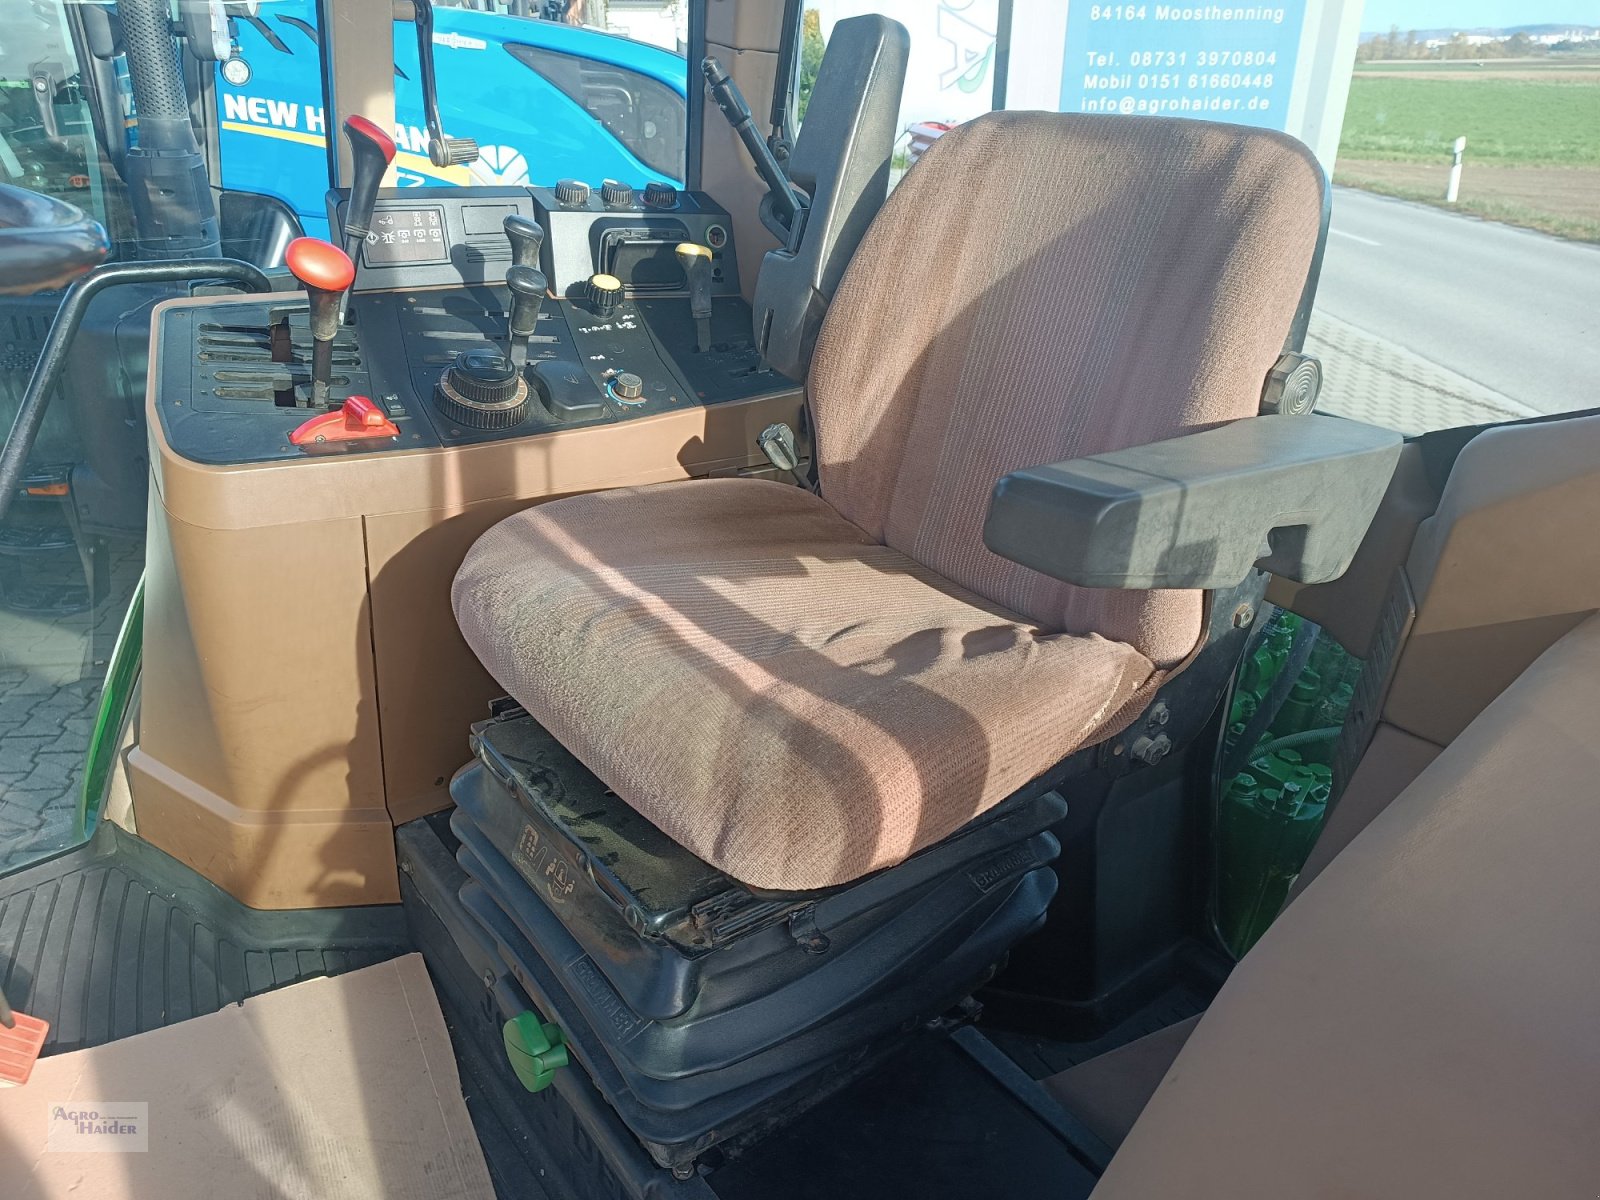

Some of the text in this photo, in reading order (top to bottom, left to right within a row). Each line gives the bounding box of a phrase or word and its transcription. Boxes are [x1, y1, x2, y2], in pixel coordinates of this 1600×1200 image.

[1090, 5, 1285, 24] 84164 Moosthenning
[1087, 51, 1277, 67] Tel. 08731 3970804
[1083, 74, 1274, 89] Mobil 0151 61660448
[223, 93, 299, 128] NEW
[1081, 96, 1270, 114] info@agrohaider.de
